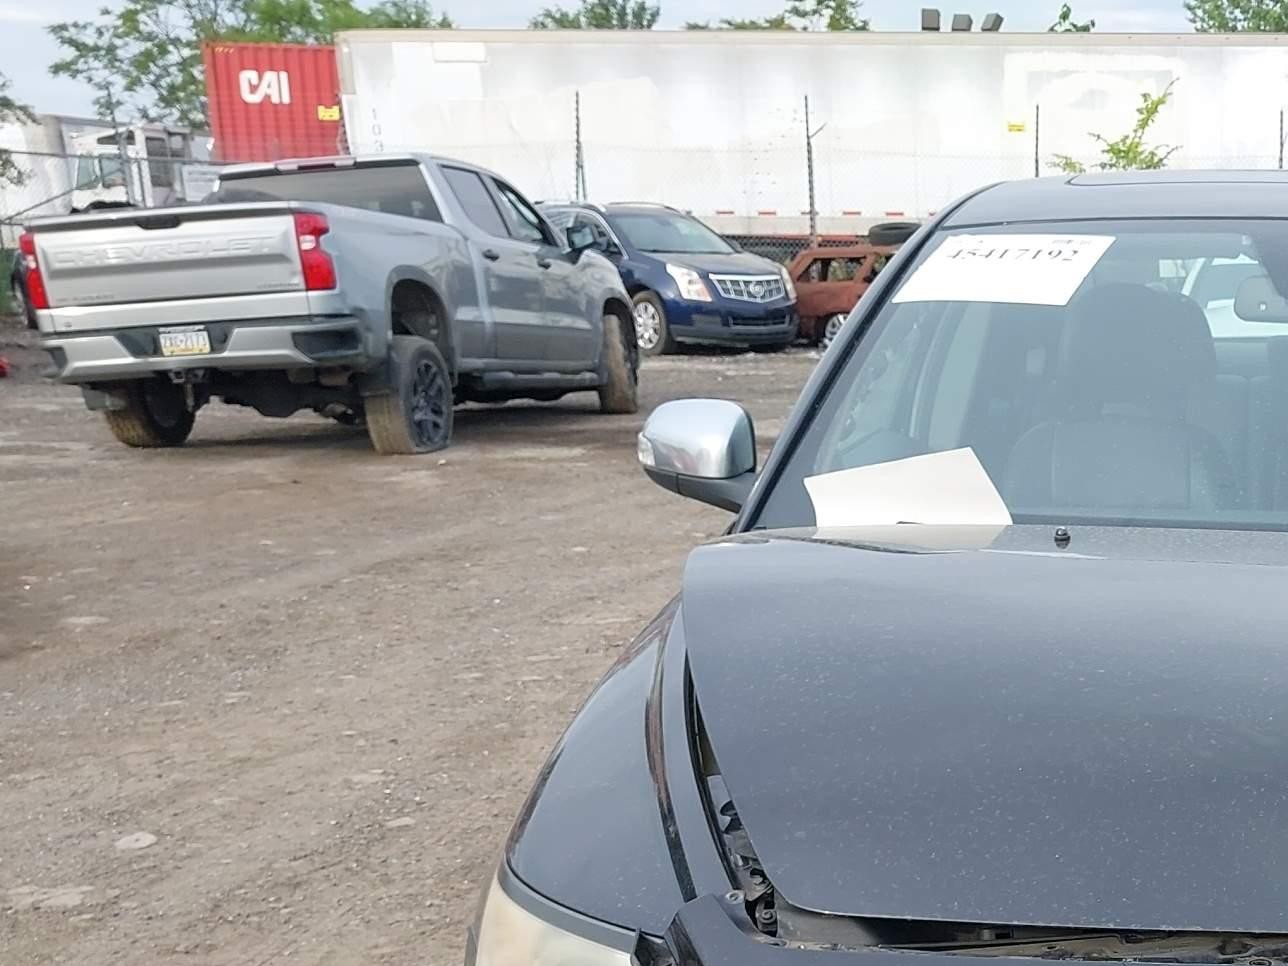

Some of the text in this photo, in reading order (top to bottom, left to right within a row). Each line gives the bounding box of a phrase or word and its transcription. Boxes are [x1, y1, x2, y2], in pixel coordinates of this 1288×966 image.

[239, 69, 291, 104] CAI
[53, 236, 277, 268] CHEVROLET
[947, 248, 1079, 261] 45417192
